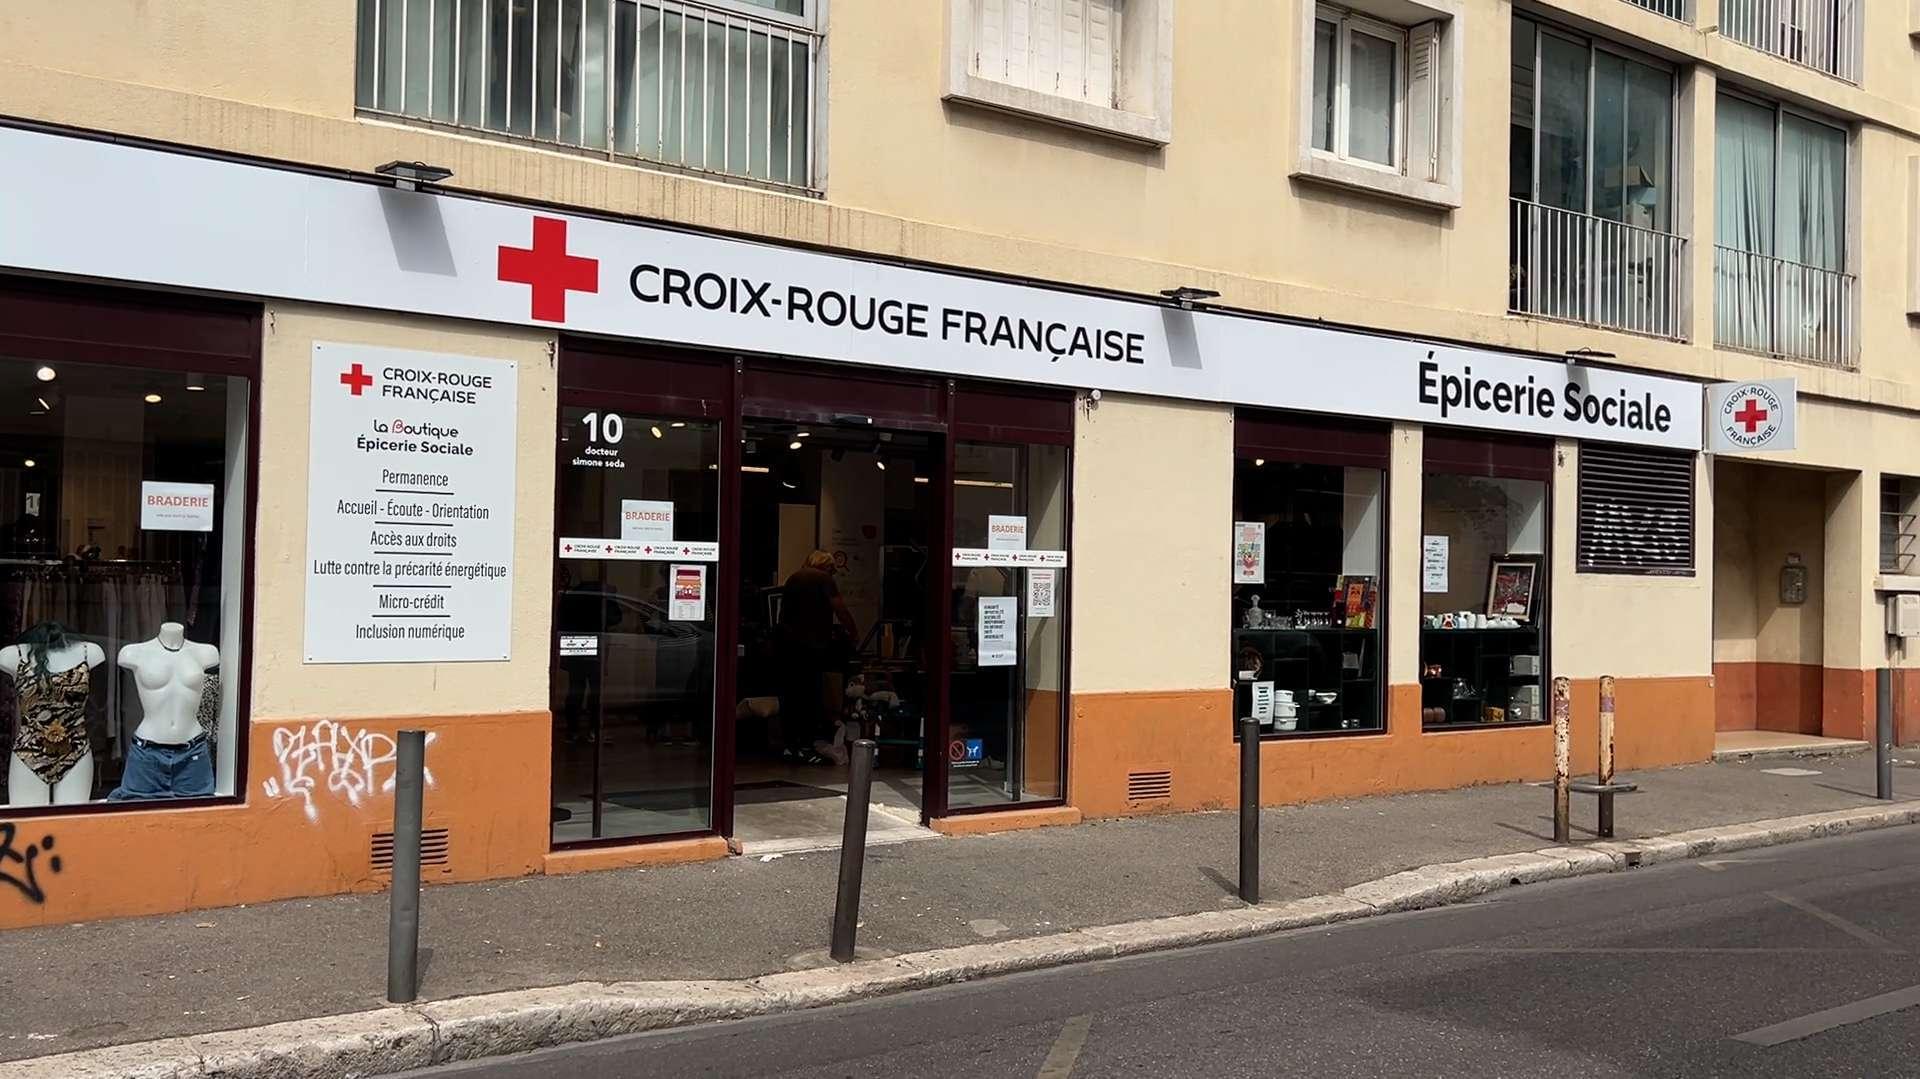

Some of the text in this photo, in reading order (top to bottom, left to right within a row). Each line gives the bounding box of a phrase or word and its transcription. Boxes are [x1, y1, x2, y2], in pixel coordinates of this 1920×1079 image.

[629, 264, 1145, 363] CROIX-ROUGE FRANÇAISE
[383, 367, 492, 389] CROIX-ROUGE
[382, 385, 476, 404] FRANÇAISE
[1419, 351, 1671, 433] Épicerie Sociale
[392, 419, 459, 439] Boutique
[582, 412, 623, 444] 10
[1726, 425, 1777, 446] FRANÇAISE
[357, 434, 474, 455] Épicerie Sociale
[585, 446, 618, 456] docteur
[572, 457, 625, 468] simone seda
[382, 468, 449, 486] Permanence
[147, 495, 209, 508] BRADERIE
[337, 499, 377, 515] Accueil
[387, 499, 423, 517] Écoute
[432, 503, 489, 519] Orientation
[625, 511, 671, 521] BRADERIE
[991, 524, 1025, 534] BRADERIE
[370, 530, 457, 548] Accès aux droits
[313, 560, 507, 580] Lutte contre la précarité énergétique
[379, 593, 445, 609] Micro-crédit
[356, 624, 465, 641] Inclusion numérique
